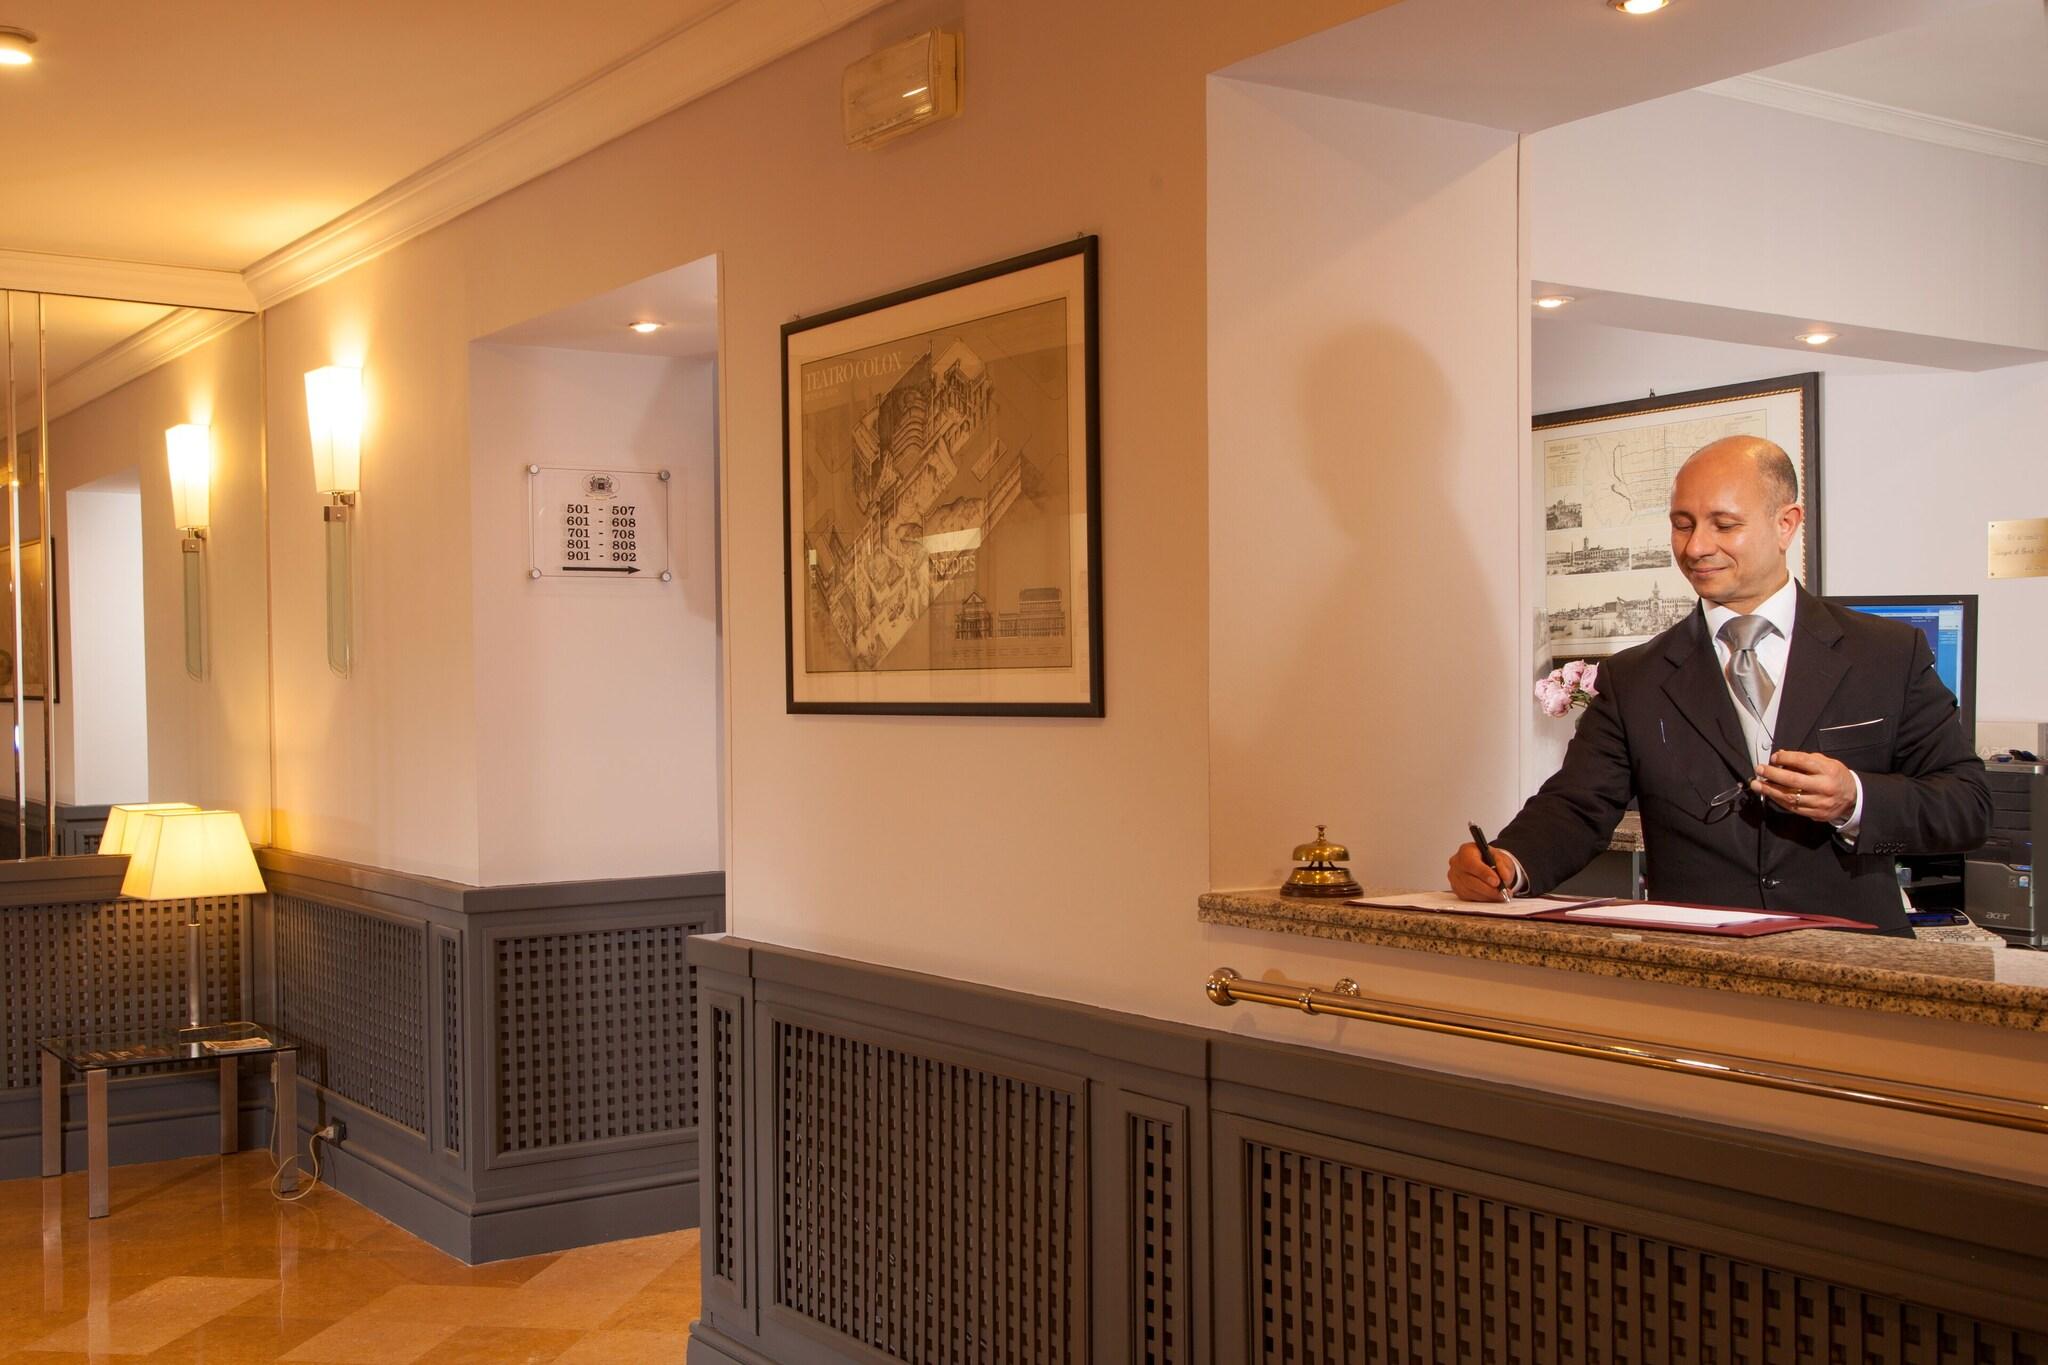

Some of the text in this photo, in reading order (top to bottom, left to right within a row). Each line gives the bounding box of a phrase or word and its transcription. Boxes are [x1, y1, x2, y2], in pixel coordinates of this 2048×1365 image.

[805, 362, 853, 391] TEATRO
[567, 504, 589, 514] 501
[612, 506, 635, 516] 507
[567, 516, 590, 526] 601
[612, 518, 636, 528] 608
[568, 528, 590, 538] 701
[612, 530, 635, 539] 708
[567, 539, 590, 549] 801
[612, 541, 636, 550] 808
[567, 551, 590, 561] 901
[612, 552, 636, 562] 902
[1985, 911, 2010, 920] acer
